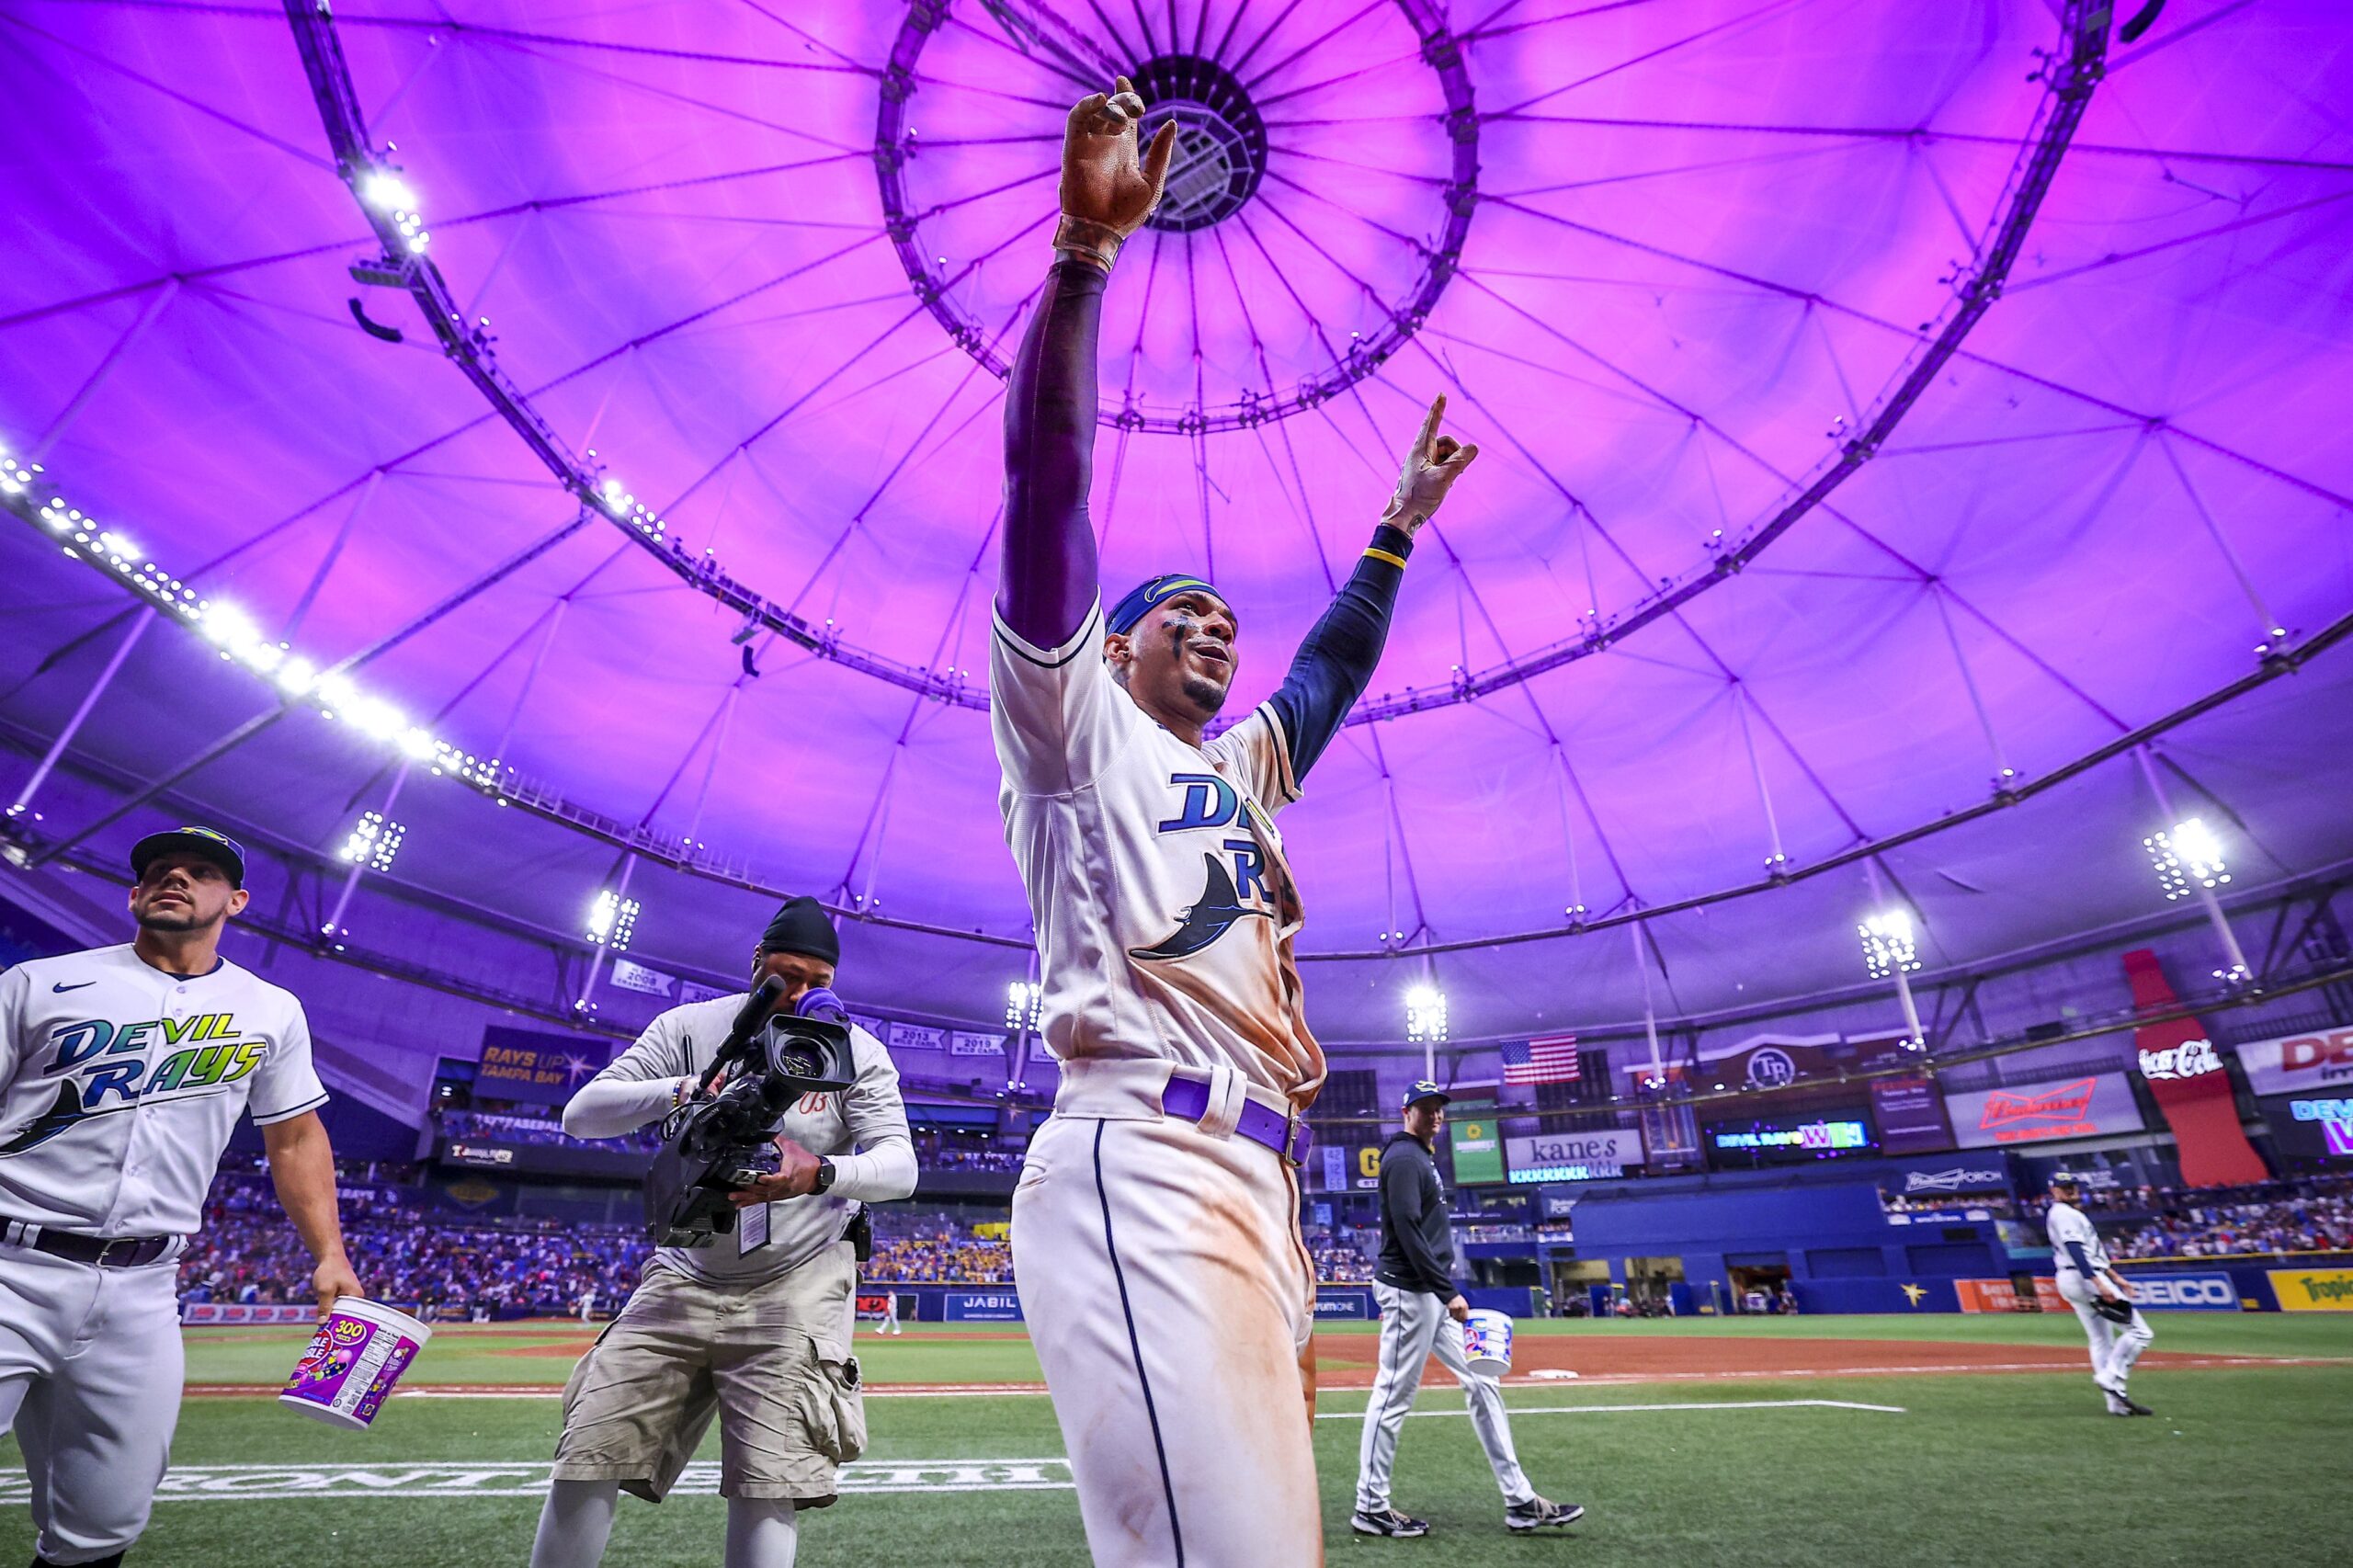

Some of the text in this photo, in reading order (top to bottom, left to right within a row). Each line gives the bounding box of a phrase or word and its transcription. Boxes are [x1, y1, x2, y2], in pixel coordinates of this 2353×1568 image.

[627, 971, 657, 987] 2008
[893, 1037, 937, 1048] WILD CARD
[902, 1029, 929, 1041] 2013
[42, 1013, 242, 1078] DEVIL
[957, 1046, 975, 1054] WILD
[964, 1039, 992, 1049] 2019
[483, 1046, 565, 1069] RAYS UP
[82, 1041, 268, 1108] RAYS
[481, 1062, 566, 1085] TAMPA BAY
[963, 1297, 1017, 1309] JABIL
[335, 1320, 363, 1337] 300
